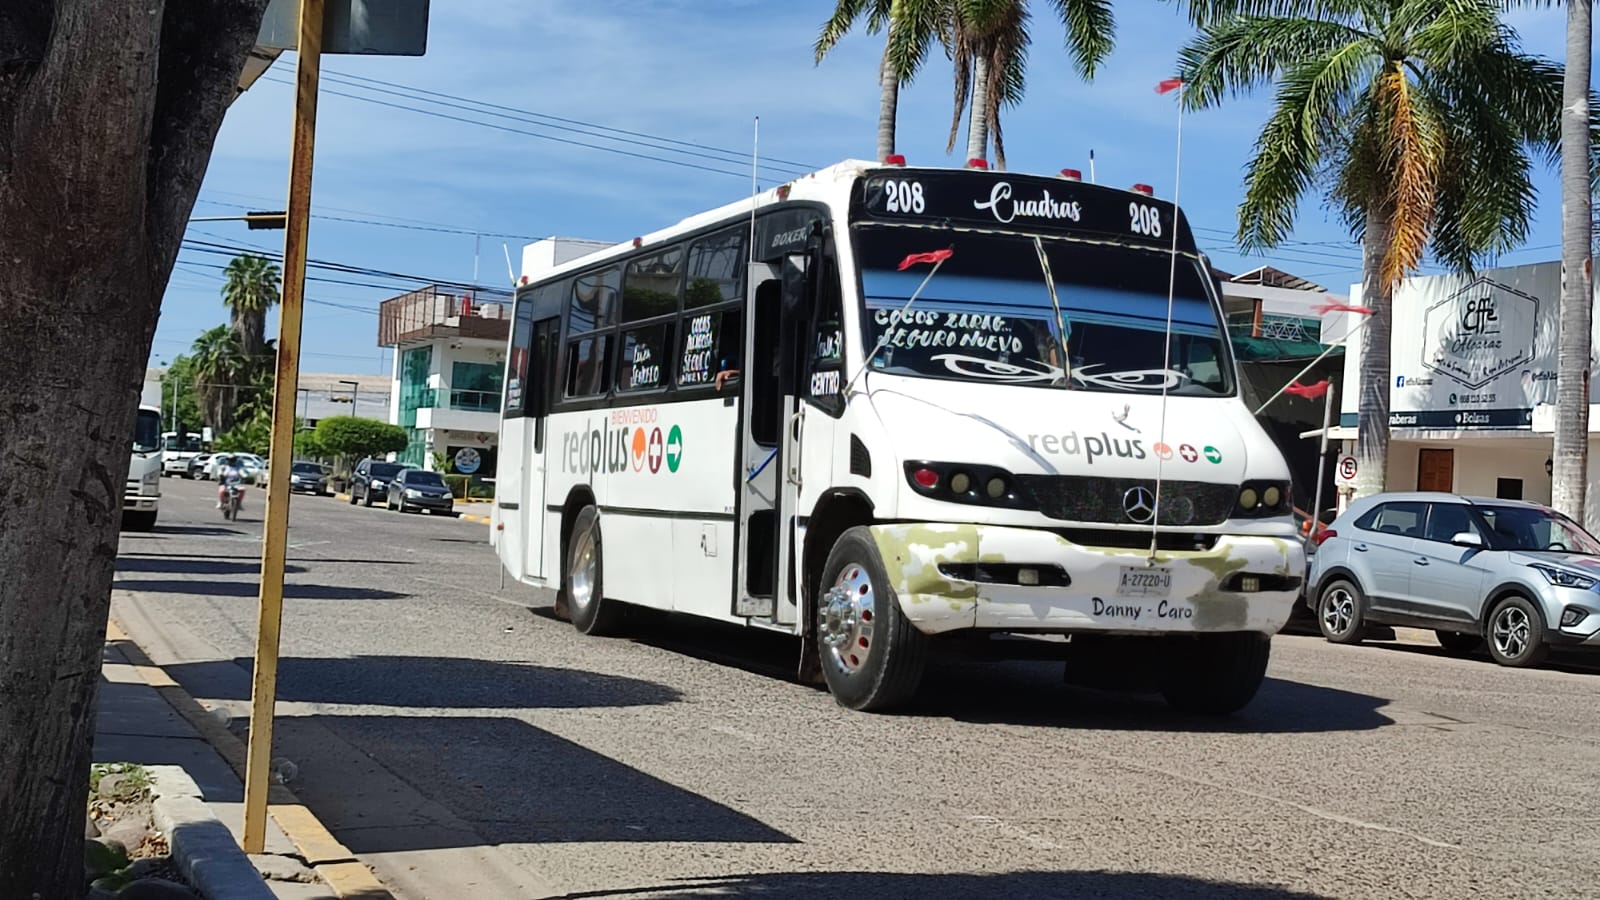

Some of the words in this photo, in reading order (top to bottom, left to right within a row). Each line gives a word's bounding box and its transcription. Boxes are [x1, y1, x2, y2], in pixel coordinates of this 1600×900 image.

[885, 180, 925, 214] 208
[973, 181, 1082, 224] Cuadras
[1129, 201, 1162, 238] 208
[874, 308, 939, 326] COCOS
[878, 327, 957, 349] SEGURO
[959, 330, 1023, 353] NUEVO
[811, 371, 840, 396] CENTRO
[611, 408, 658, 425] BIENVENIDO
[562, 416, 629, 486] redplus
[1028, 430, 1146, 465] redplus
[1344, 461, 1353, 474] E
[1121, 573, 1171, 588] A-27220-U
[1092, 597, 1142, 620] Danny
[1158, 600, 1193, 619] Caro
